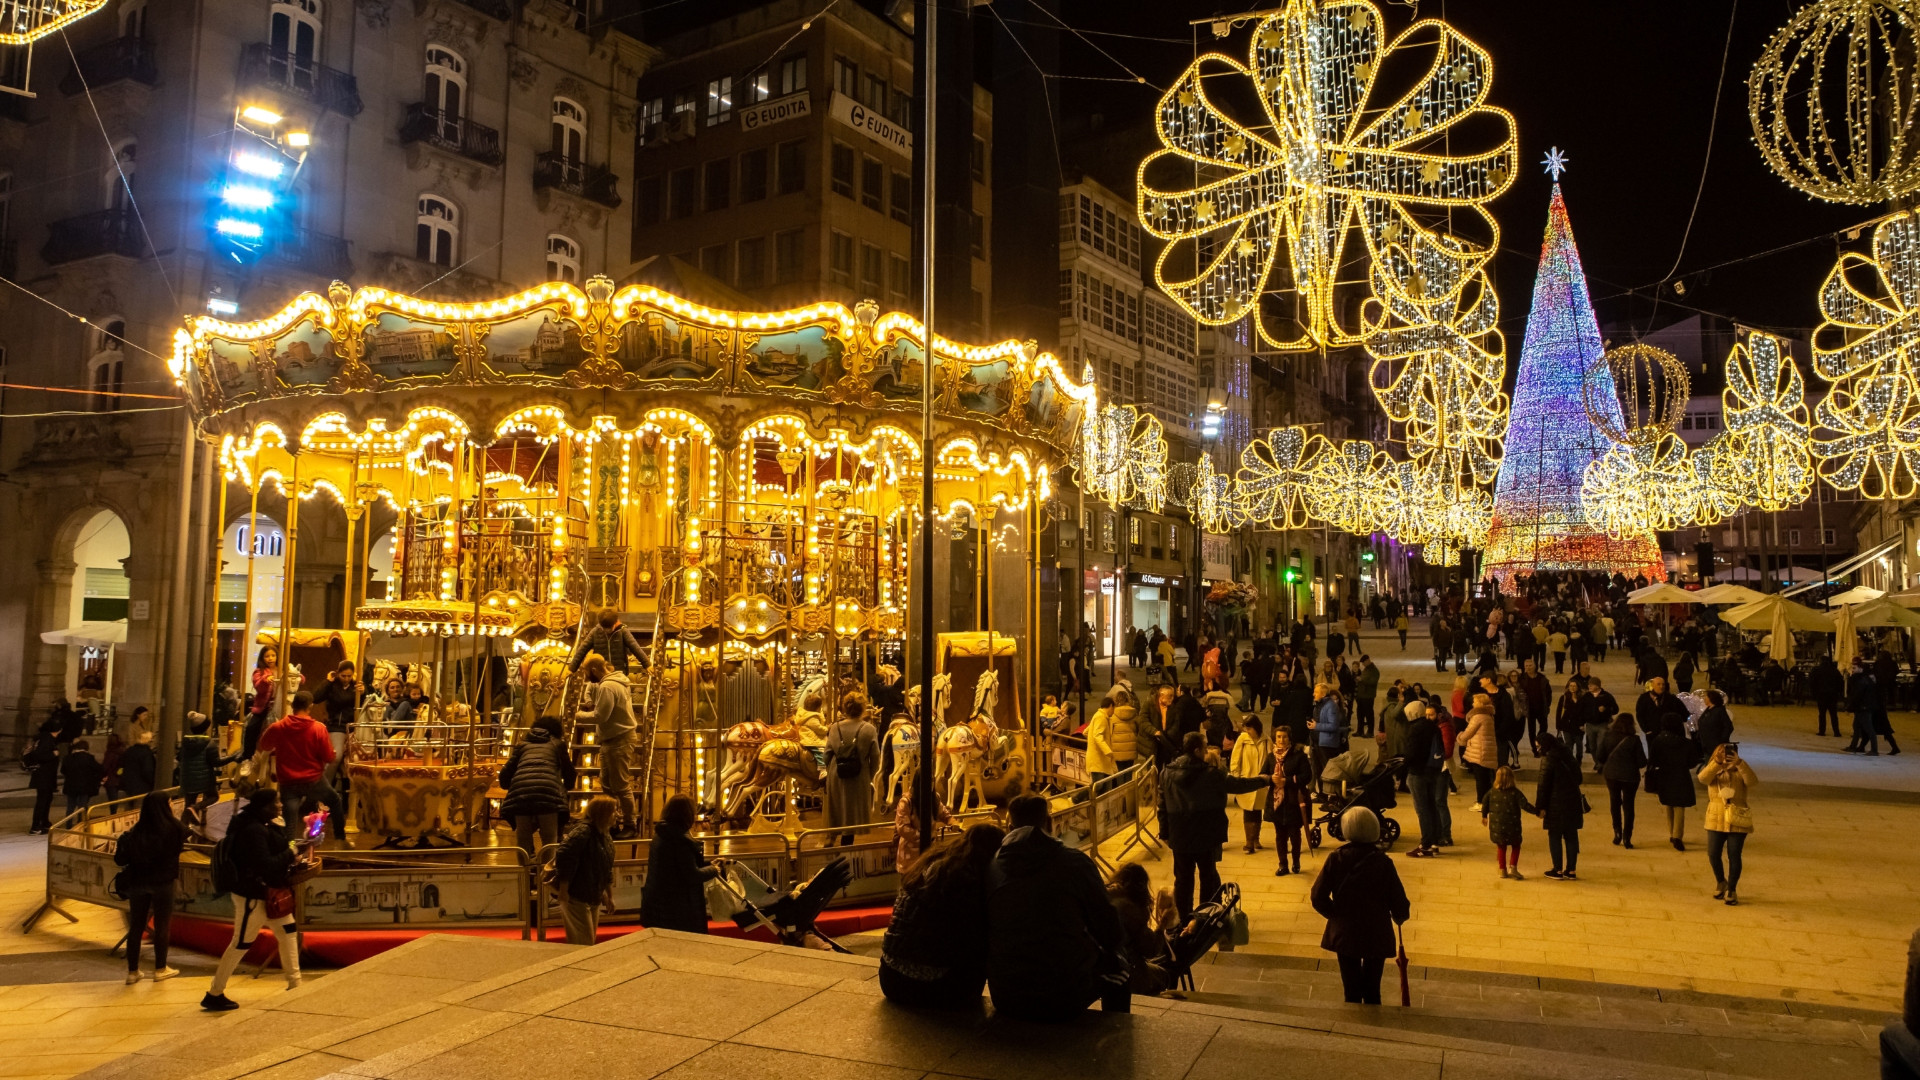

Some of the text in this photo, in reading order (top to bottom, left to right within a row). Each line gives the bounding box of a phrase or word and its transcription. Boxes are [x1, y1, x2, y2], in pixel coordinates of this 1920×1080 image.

[761, 100, 806, 123] EUDITA
[867, 117, 905, 147] EUDITA
[1148, 575, 1165, 585] Computer
